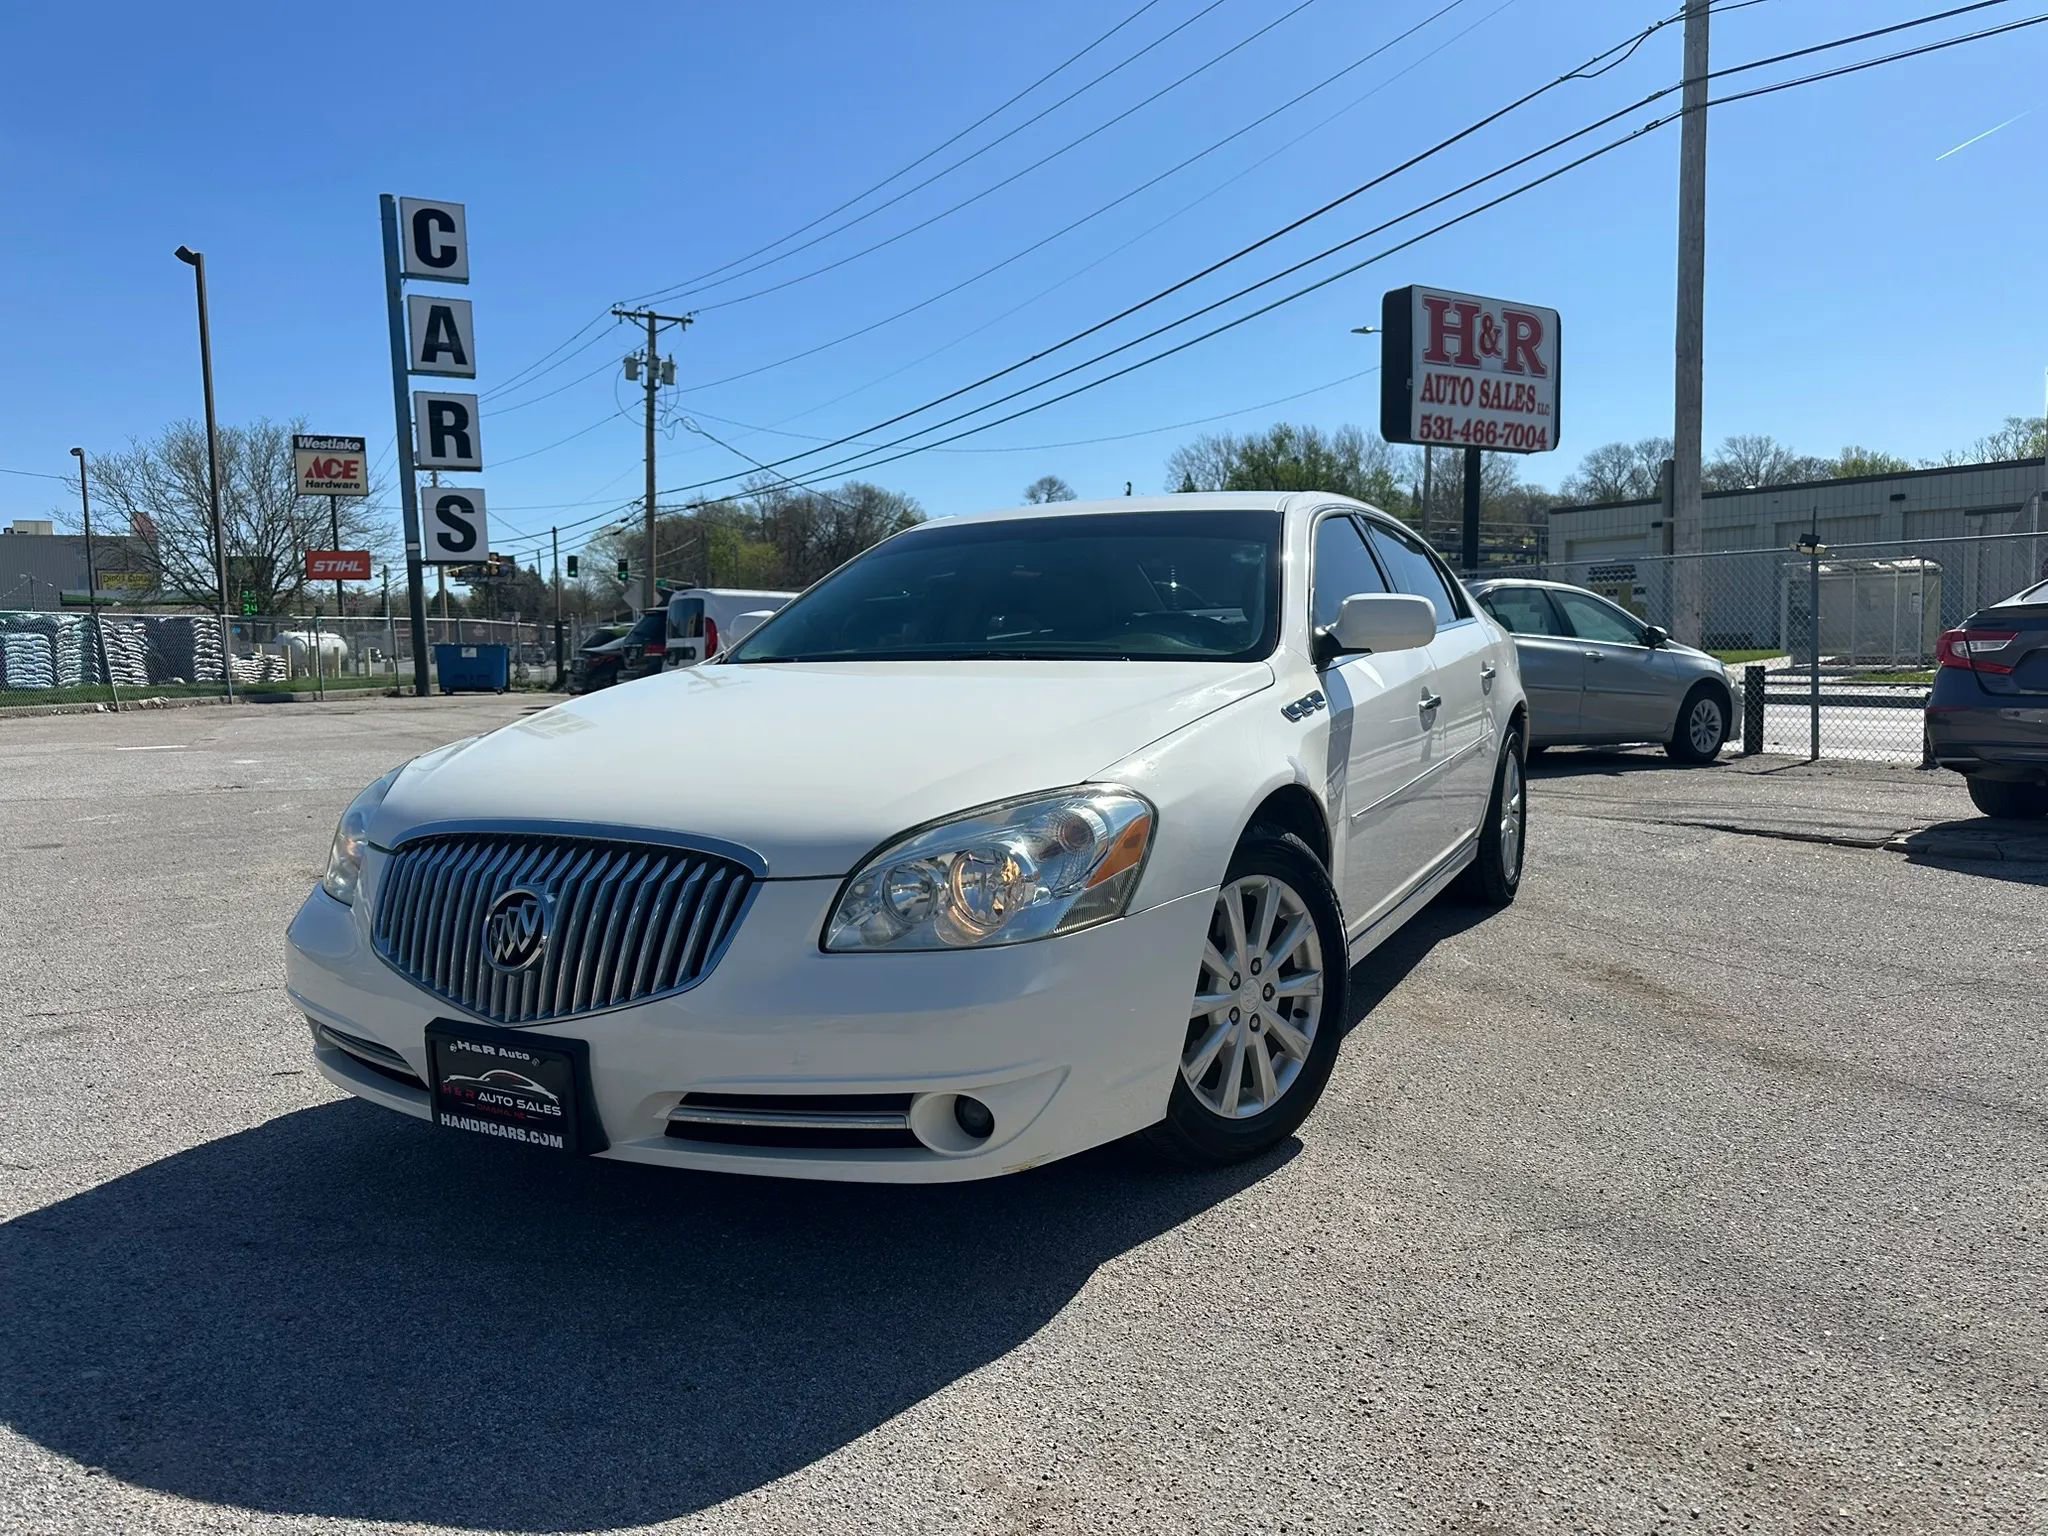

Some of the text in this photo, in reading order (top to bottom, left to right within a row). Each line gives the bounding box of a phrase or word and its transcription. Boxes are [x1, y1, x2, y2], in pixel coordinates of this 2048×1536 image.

[1421, 295, 1547, 379] H&R
[1420, 373, 1474, 407] AUTO
[1479, 378, 1536, 414] SALES
[1419, 413, 1547, 449] 531-466-7004
[298, 436, 361, 450] Westlake
[304, 456, 359, 479] ACE
[305, 480, 360, 489] Hardware
[312, 560, 364, 572] STIHL
[457, 1040, 530, 1060] H&R Auto
[478, 1092, 513, 1106] AUTO
[516, 1099, 561, 1116] SALES
[440, 1112, 563, 1149] HANDRCARS.COM
